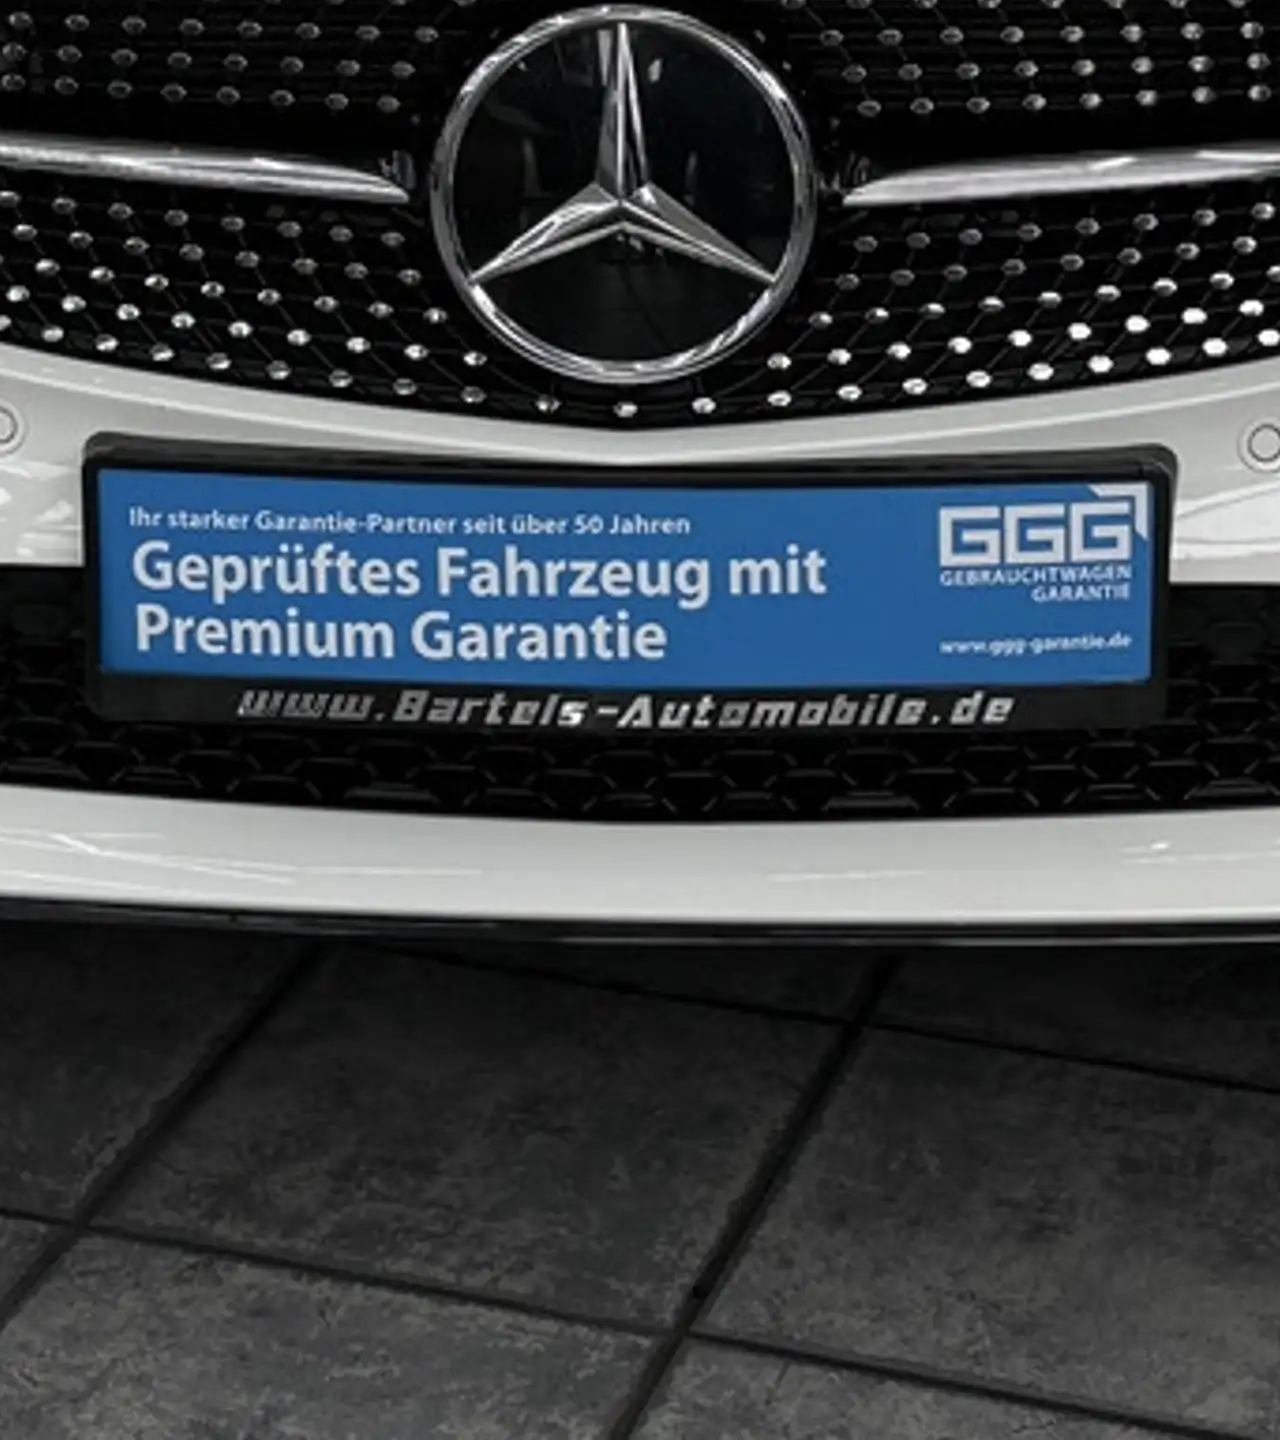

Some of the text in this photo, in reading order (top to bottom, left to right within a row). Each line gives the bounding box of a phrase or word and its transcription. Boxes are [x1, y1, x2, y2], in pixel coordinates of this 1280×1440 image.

[128, 507, 691, 535] Ihr starker Garantie-Partner seit über 50 Jahren
[939, 501, 1131, 567] GGG
[132, 540, 827, 609] Geprüftes Fahrzeug mit
[939, 565, 1132, 587] GEBRAUCHTWAGEN
[1031, 584, 1131, 602] GARANTIE
[136, 604, 667, 661] Premium Garantie
[939, 631, 1133, 657] www.ggg-garantie.de
[237, 690, 1014, 730] www.Bartels-Automobile.de
